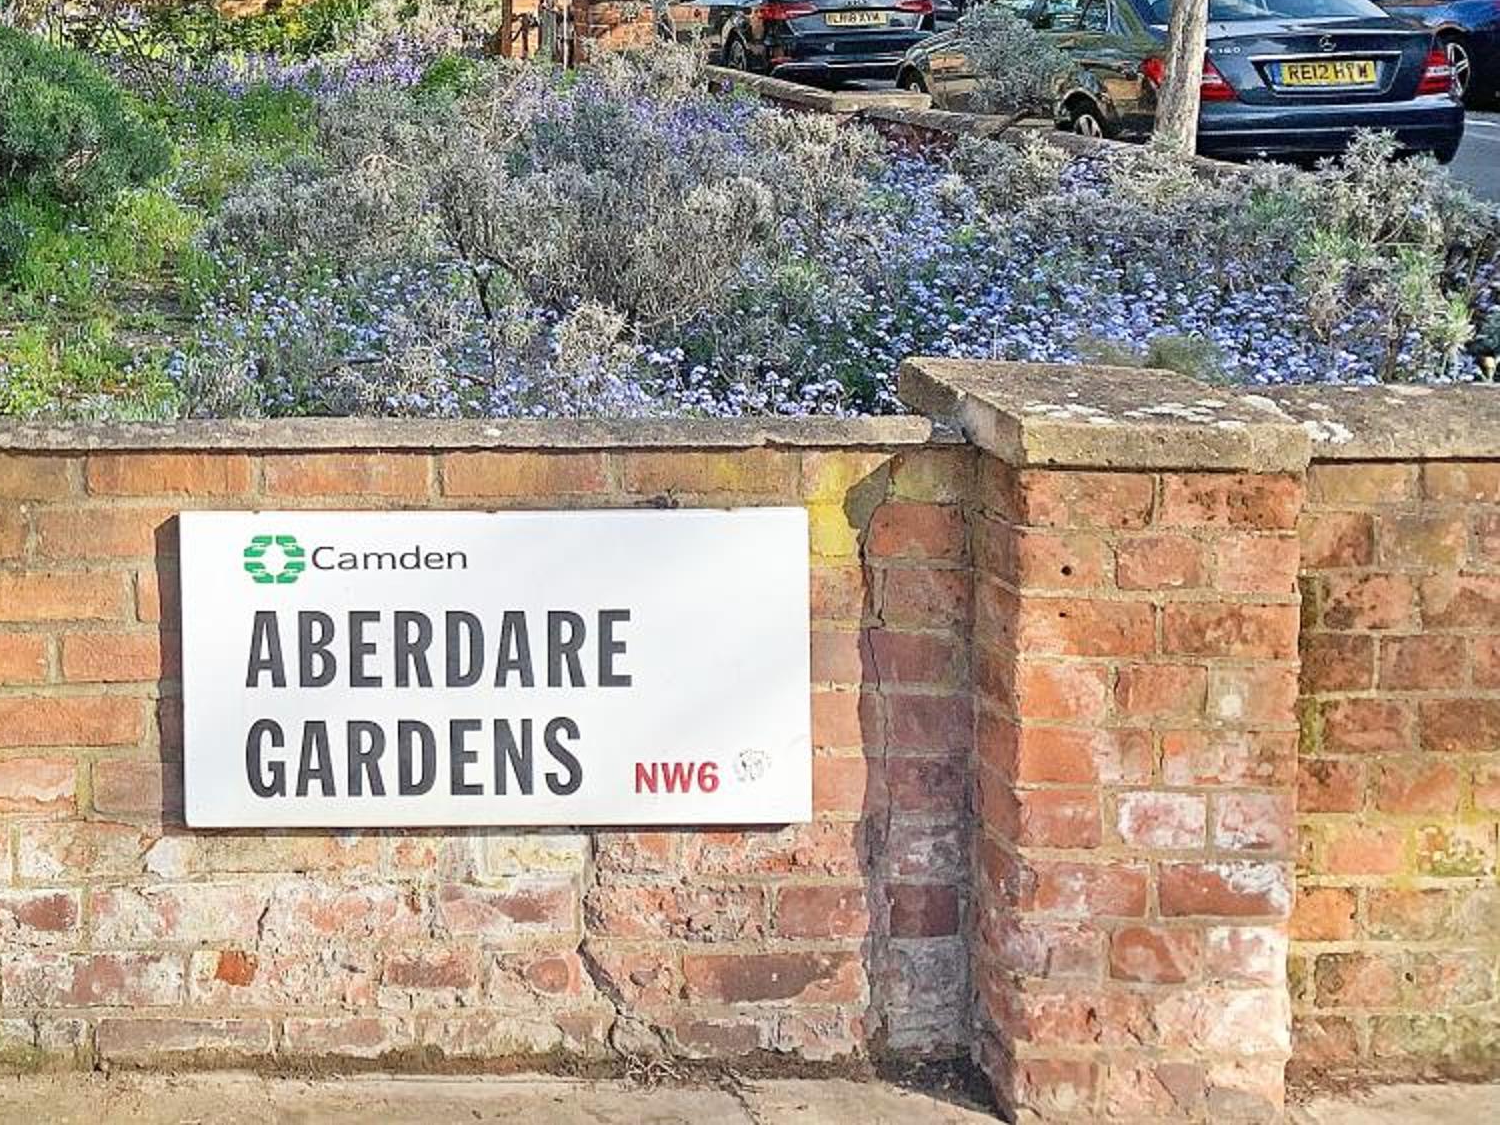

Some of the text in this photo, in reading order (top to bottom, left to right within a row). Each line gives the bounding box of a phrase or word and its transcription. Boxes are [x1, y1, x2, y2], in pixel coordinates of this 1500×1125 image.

[1287, 64, 1329, 80] RE12
[311, 545, 467, 570] Camden
[245, 608, 632, 688] ABERDARE
[245, 716, 583, 798] GARDENS
[634, 761, 720, 794] NW6
